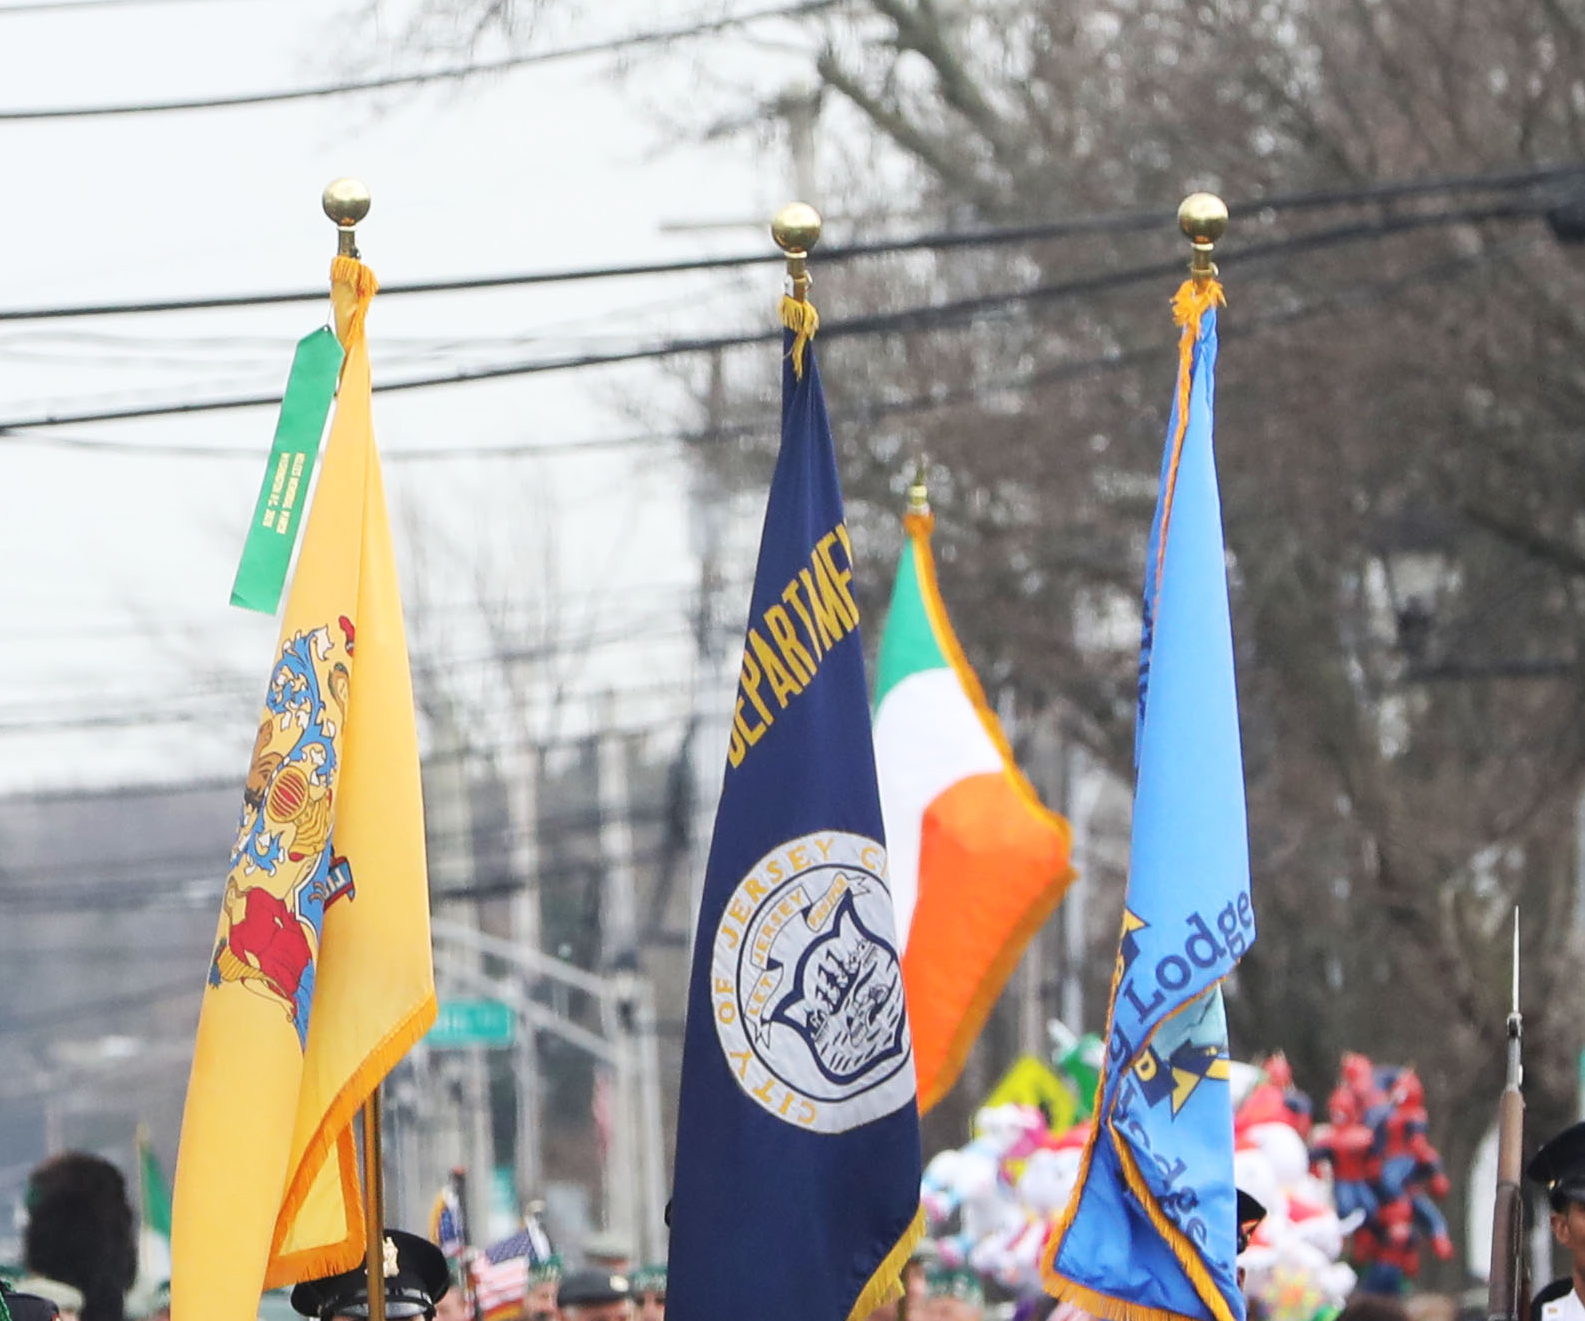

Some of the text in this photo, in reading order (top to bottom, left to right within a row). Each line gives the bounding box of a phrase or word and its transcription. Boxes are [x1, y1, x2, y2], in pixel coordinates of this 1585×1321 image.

[719, 838, 835, 950] JERSEY
[714, 977, 737, 1024] OF
[1121, 889, 1254, 1025] Lodge
